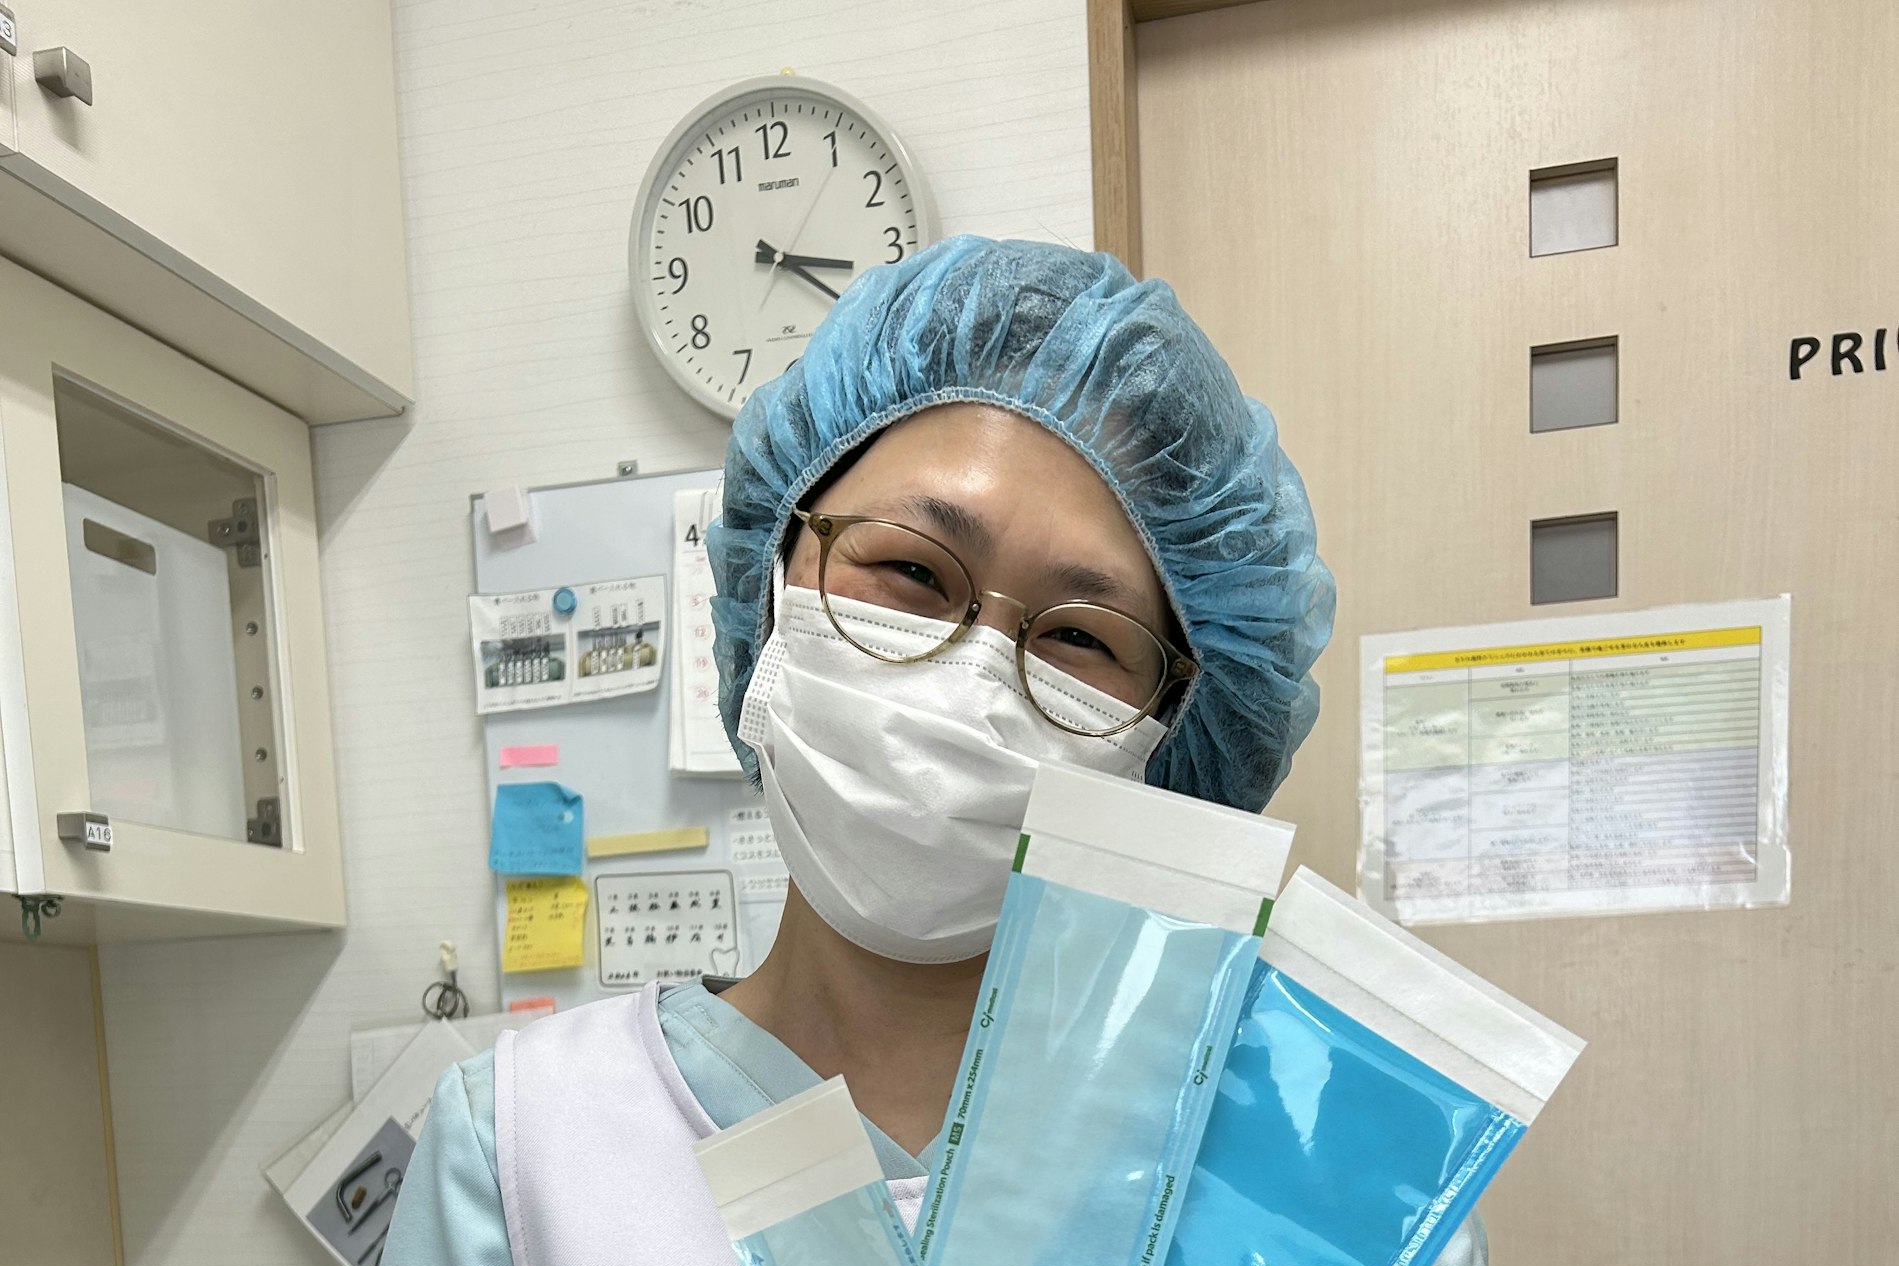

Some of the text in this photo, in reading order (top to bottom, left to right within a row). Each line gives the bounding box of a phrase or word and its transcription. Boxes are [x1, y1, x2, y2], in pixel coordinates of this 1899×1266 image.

[0, 20, 12, 38] 3
[755, 121, 791, 160] 12
[823, 130, 838, 167] 1
[711, 146, 742, 184] 11
[758, 177, 799, 191] maruman
[863, 170, 885, 208] 2
[678, 196, 713, 233] 10
[884, 226, 904, 264] 3
[668, 257, 688, 294] 9
[690, 314, 711, 349] 8
[732, 348, 752, 384] 7
[1789, 326, 1899, 380] PRI
[685, 524, 700, 546] 4
[87, 826, 112, 842] A16
[927, 1175, 947, 1229] Sterilization
[941, 1148, 955, 1176] Pouch
[957, 1089, 972, 1119] 70mm
[967, 1049, 983, 1083] 254mm
[1156, 1174, 1176, 1222] damaged
[1146, 1232, 1159, 1256] pack
[1153, 1222, 1161, 1232] is
[1141, 1255, 1151, 1265] if
